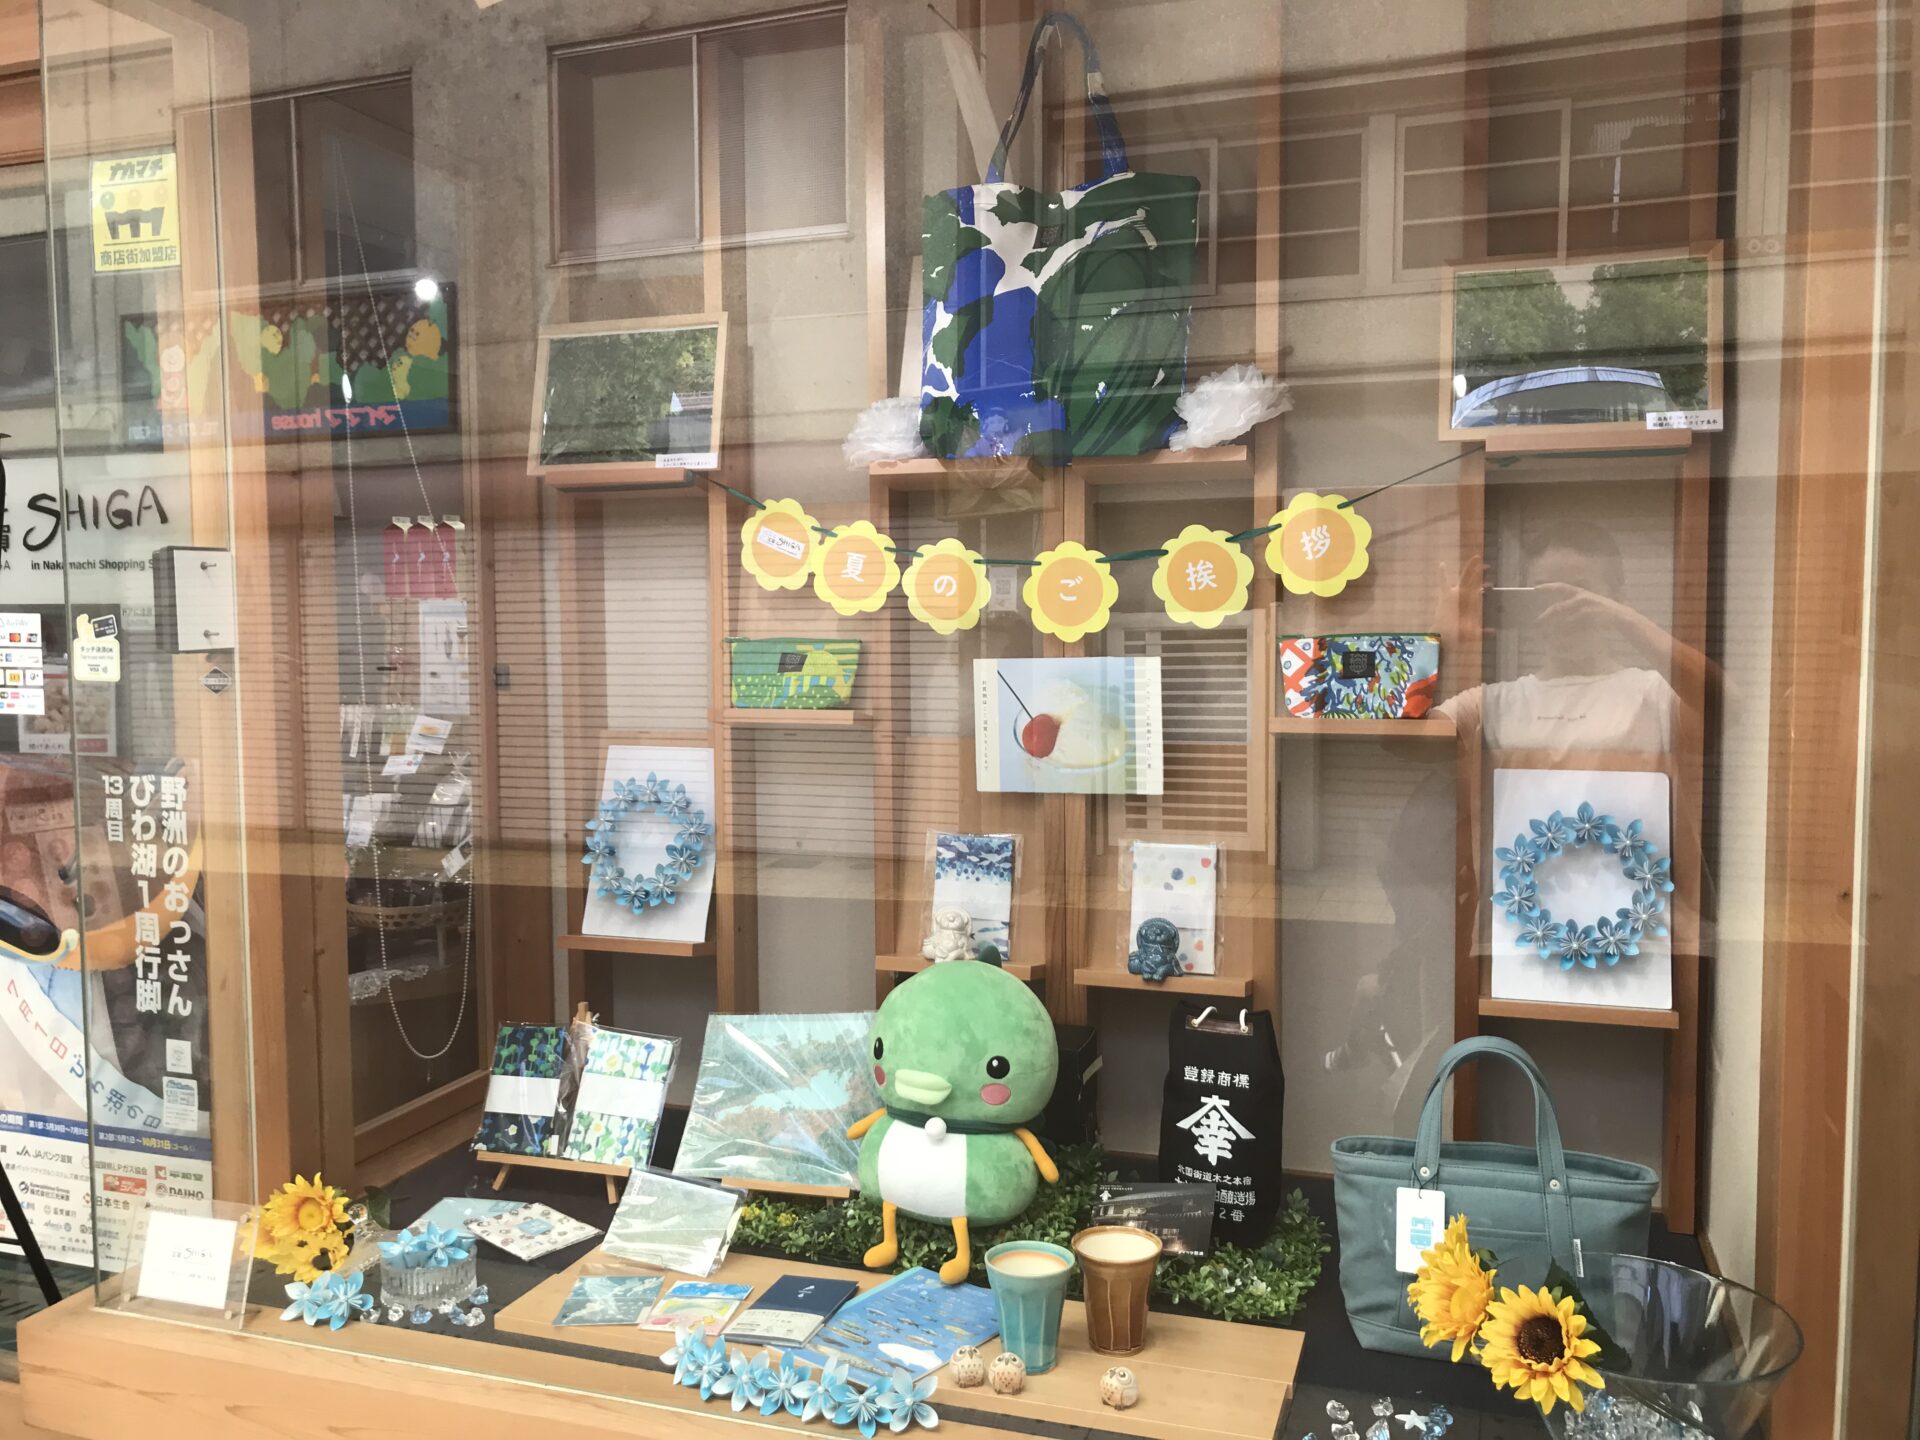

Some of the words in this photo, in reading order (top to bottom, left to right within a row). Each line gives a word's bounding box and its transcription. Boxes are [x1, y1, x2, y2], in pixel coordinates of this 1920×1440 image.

[100, 245, 177, 266] 商店街加盟店
[23, 485, 169, 551] SHIGA
[31, 560, 40, 570] in
[99, 560, 145, 573] Shopping
[841, 551, 865, 583] 夏
[933, 574, 957, 596] の
[1058, 575, 1083, 602] ご
[1186, 560, 1218, 591] 挨
[1300, 523, 1332, 560] 拶
[102, 775, 124, 842] 13周目
[129, 775, 162, 1014] びわ湖1周行脚
[160, 776, 192, 1017] 野洲のおっさん
[1183, 1065, 1250, 1089] 登録商標
[1177, 1164, 1252, 1186] 北国街道木之本宿
